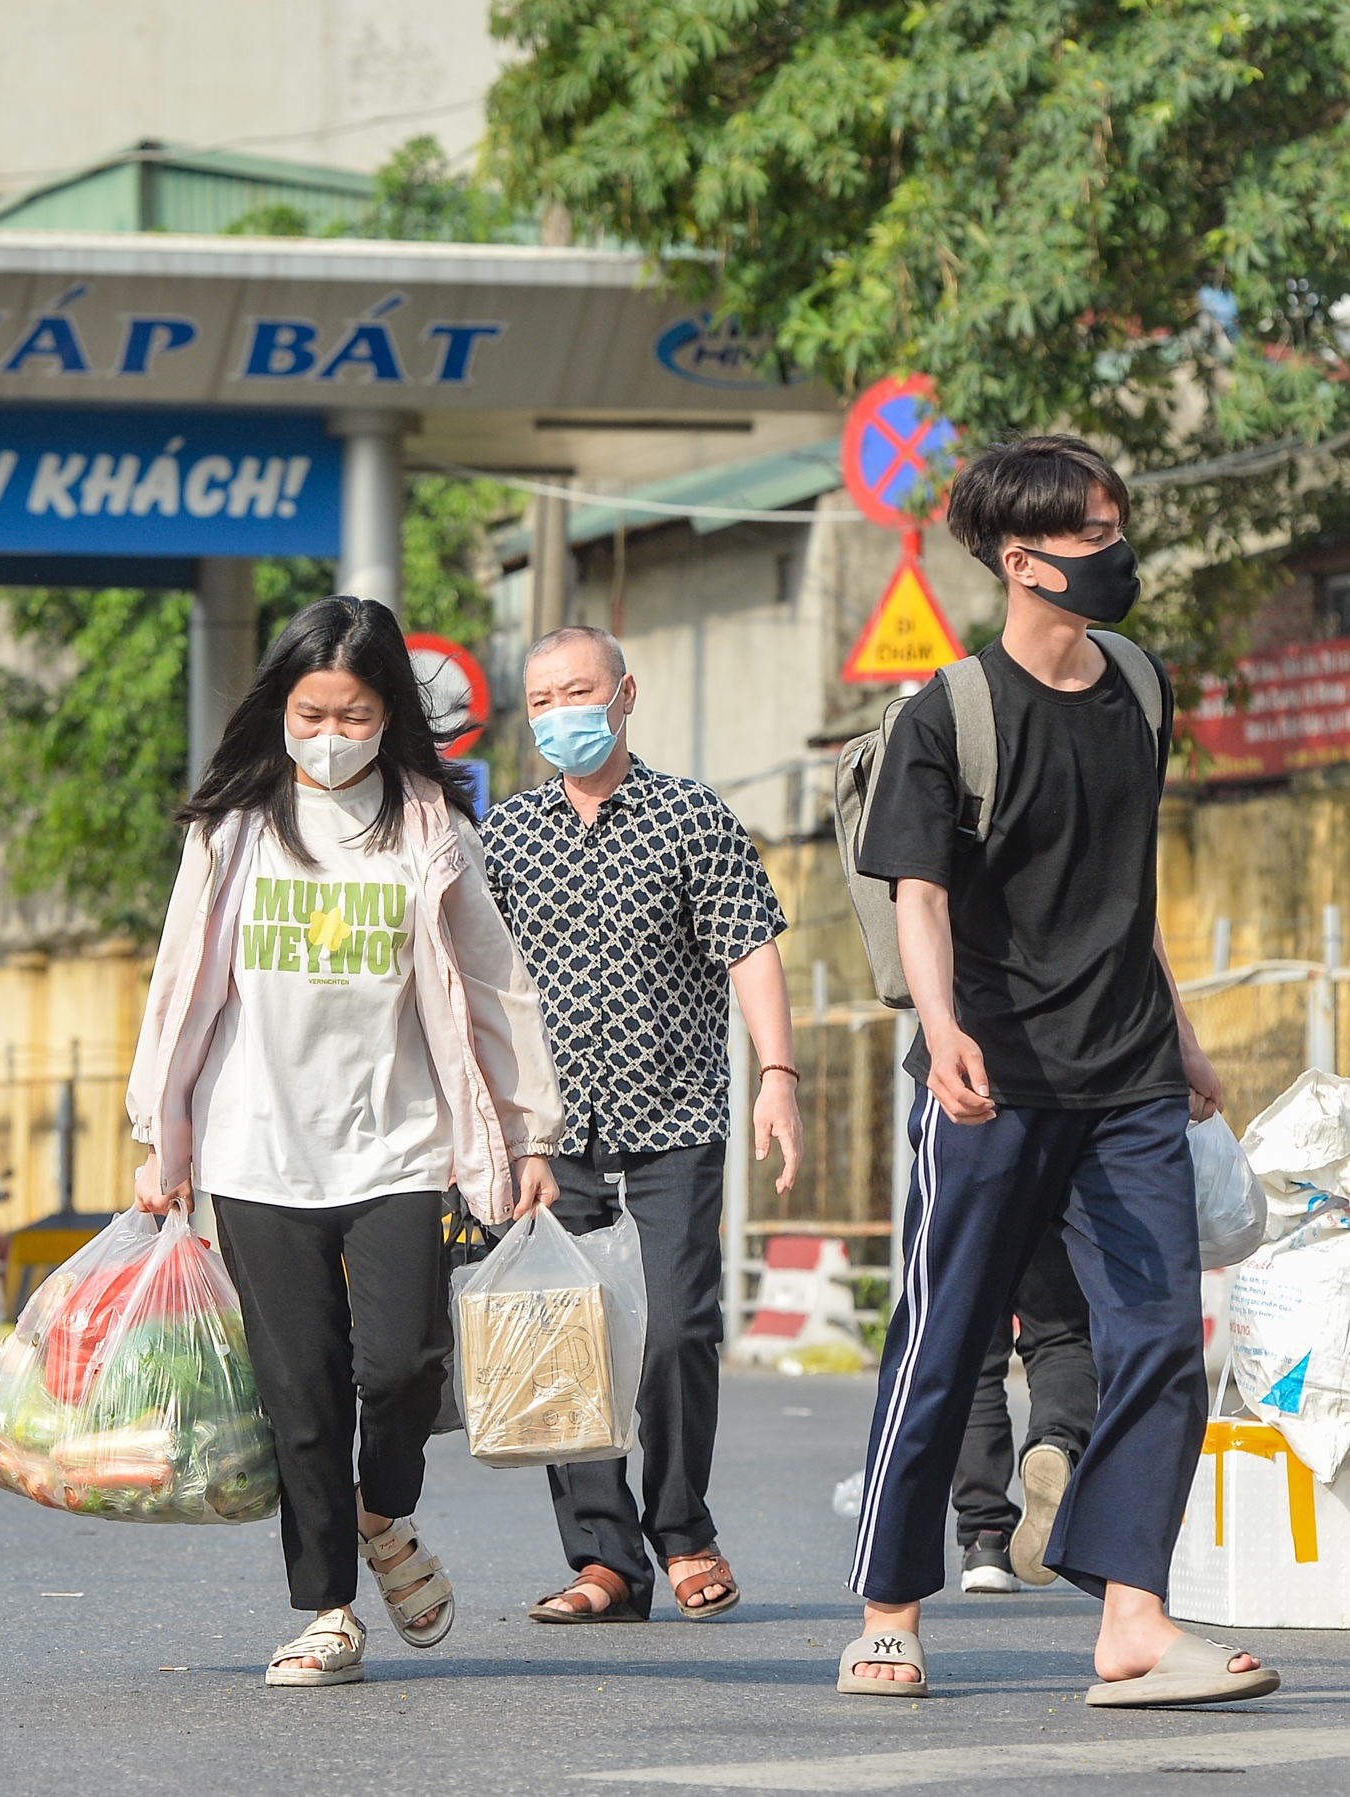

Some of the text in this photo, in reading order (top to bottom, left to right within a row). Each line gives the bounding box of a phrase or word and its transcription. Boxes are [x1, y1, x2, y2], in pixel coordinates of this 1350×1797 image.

[240, 293, 505, 382] BÁT
[26, 435, 311, 519] KHÁCH!
[253, 877, 407, 928] MUYMU
[308, 978, 350, 986] VERNICHTEN
